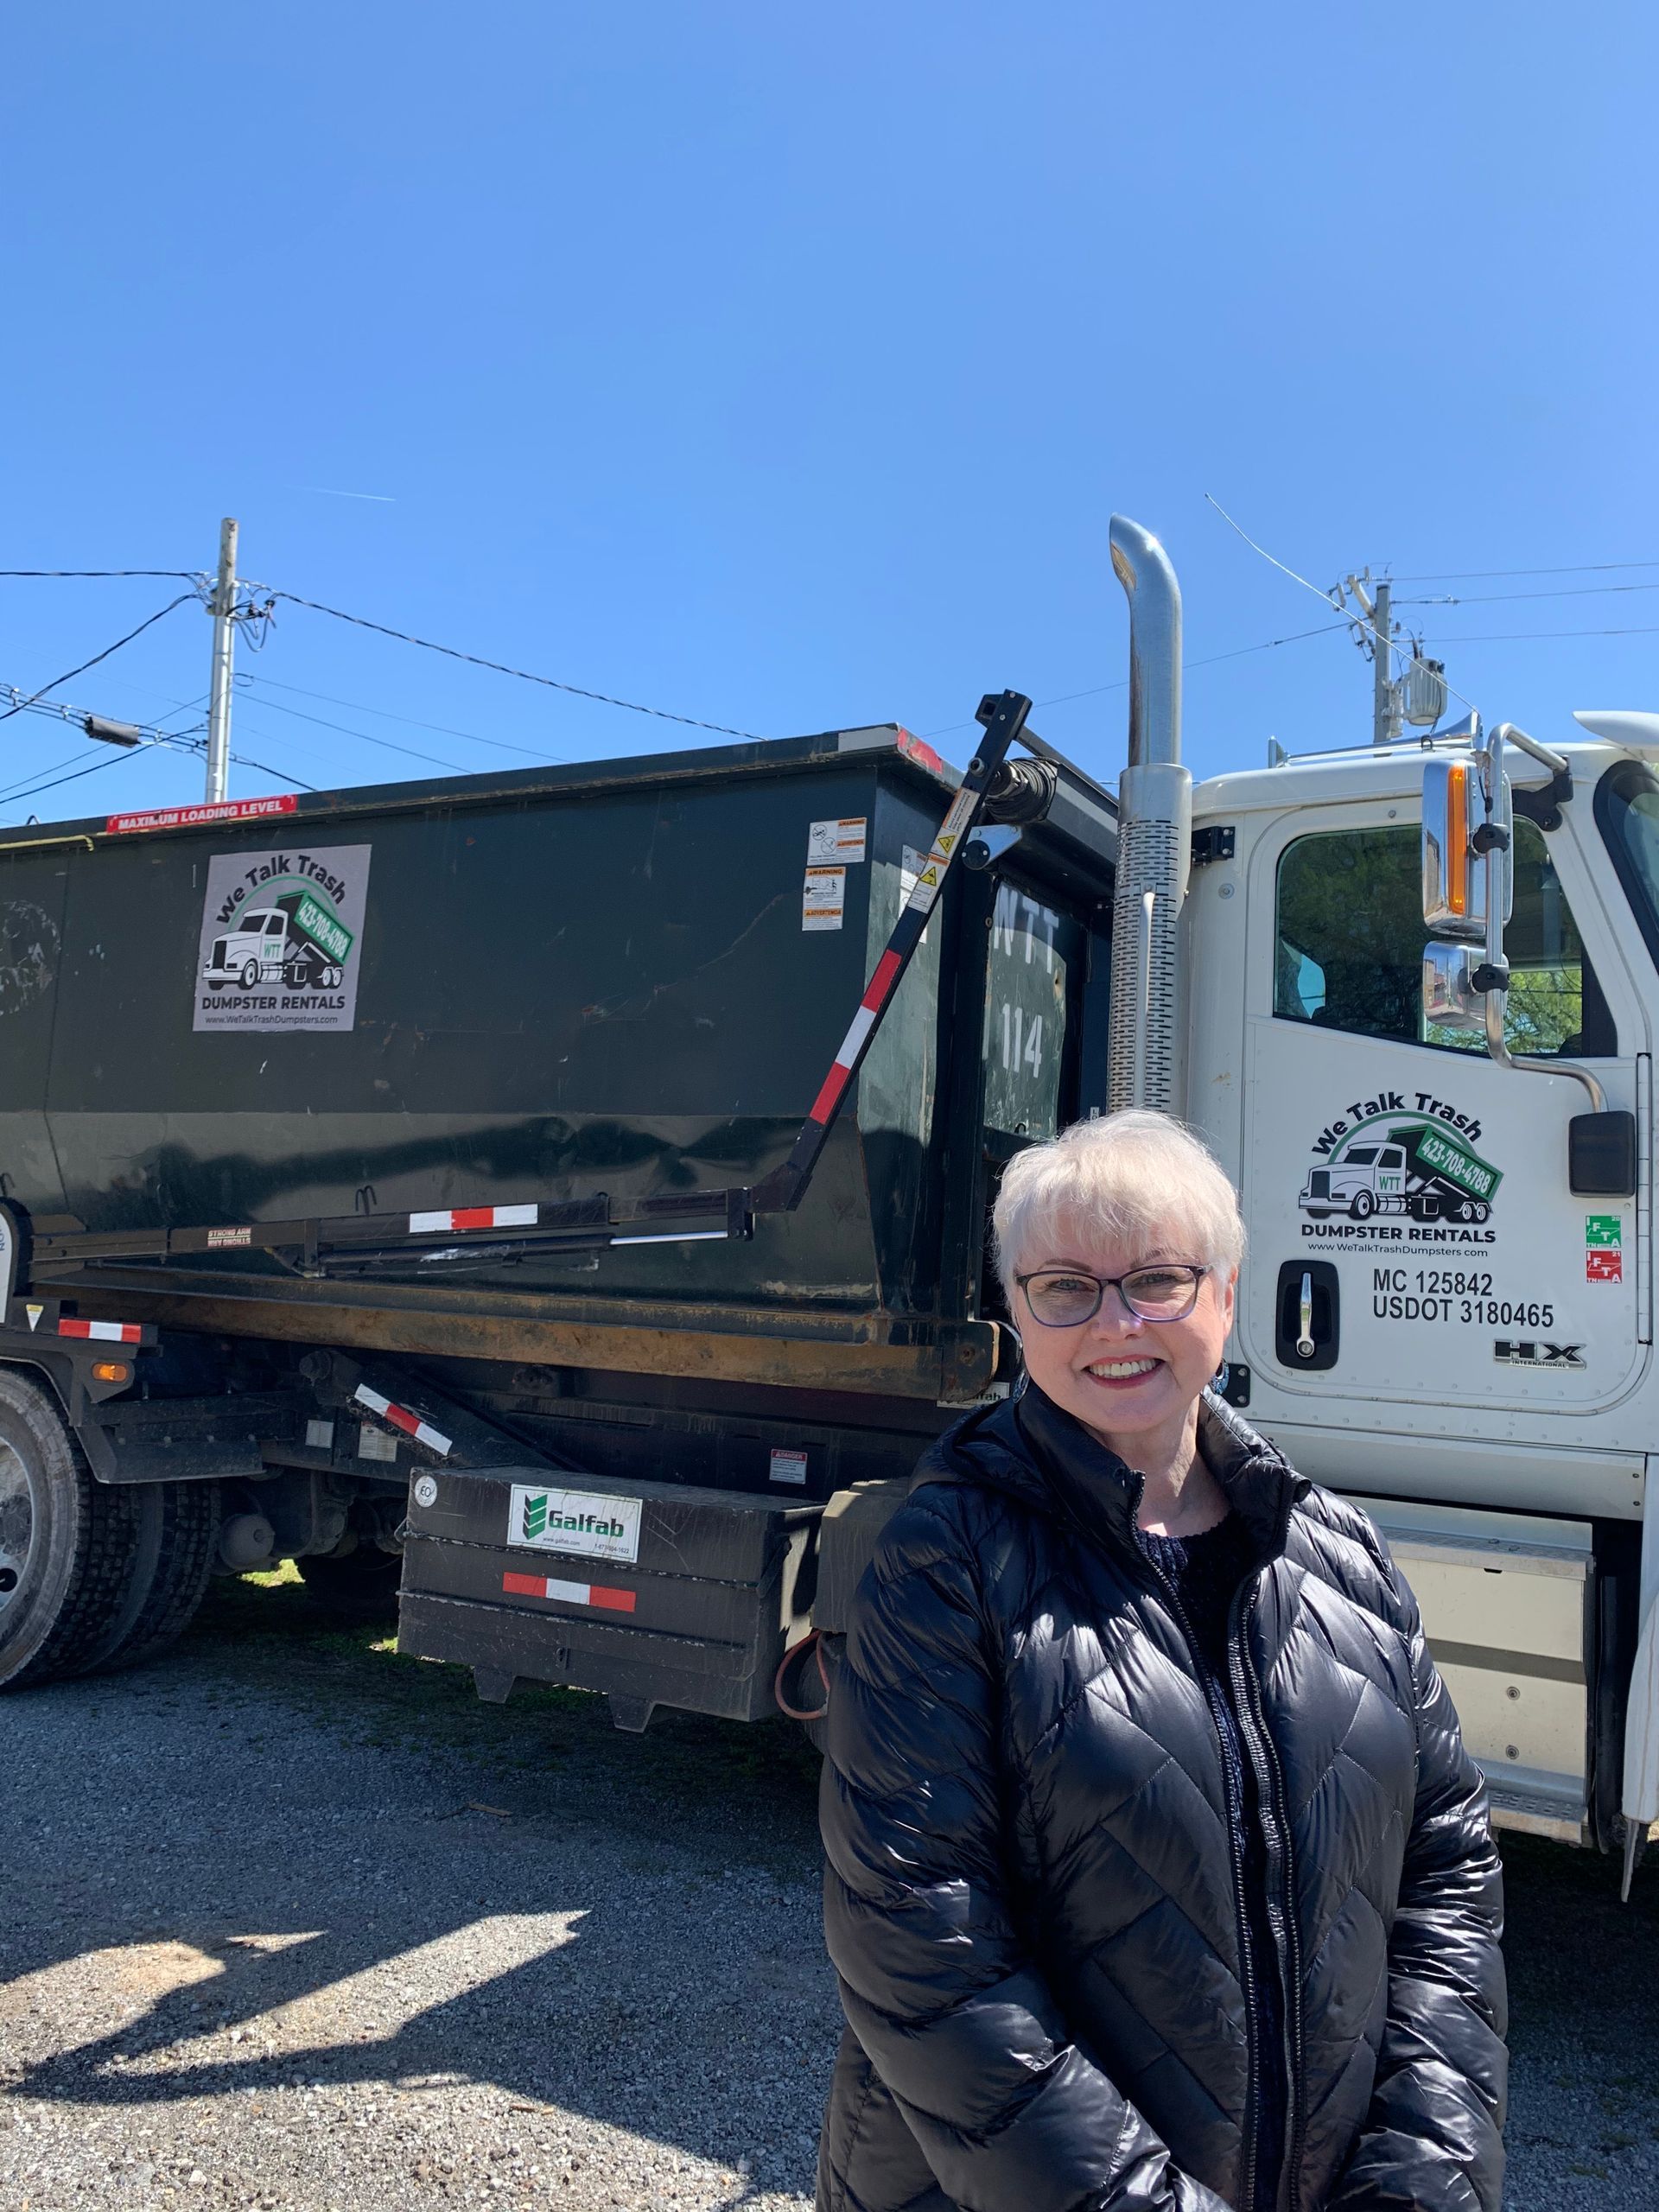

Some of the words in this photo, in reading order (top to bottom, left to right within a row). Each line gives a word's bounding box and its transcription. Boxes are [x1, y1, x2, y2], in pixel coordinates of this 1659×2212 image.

[181, 804, 238, 823] LOADING
[241, 800, 283, 816] LEVEL
[216, 887, 245, 925] We
[245, 855, 290, 887] Talk
[297, 855, 346, 905] Trash
[264, 944, 282, 958] WTT
[201, 996, 276, 1010] DUMPSTER
[280, 995, 346, 1009] RENTALS
[204, 1014, 339, 1025] www.WeTalkTrashDumpsters.com
[1001, 1002, 1043, 1079] 114
[1311, 1121, 1349, 1155] We
[1346, 1091, 1406, 1122] Talk
[1414, 1092, 1483, 1142] Trash
[1421, 1137, 1492, 1195] 423-708-4788
[1379, 1176, 1402, 1191] WTT
[1301, 1224, 1402, 1240] DUMPSTER
[1408, 1228, 1497, 1243] RENTALS
[1373, 1268, 1407, 1292] MC
[1416, 1270, 1493, 1296] 125842
[1373, 1295, 1453, 1321] USDOT
[1460, 1300, 1554, 1328] 3180465
[1494, 1339, 1586, 1363] HX
[1511, 1359, 1567, 1369] INTERNATIONAL
[549, 1510, 624, 1538] Galfab
